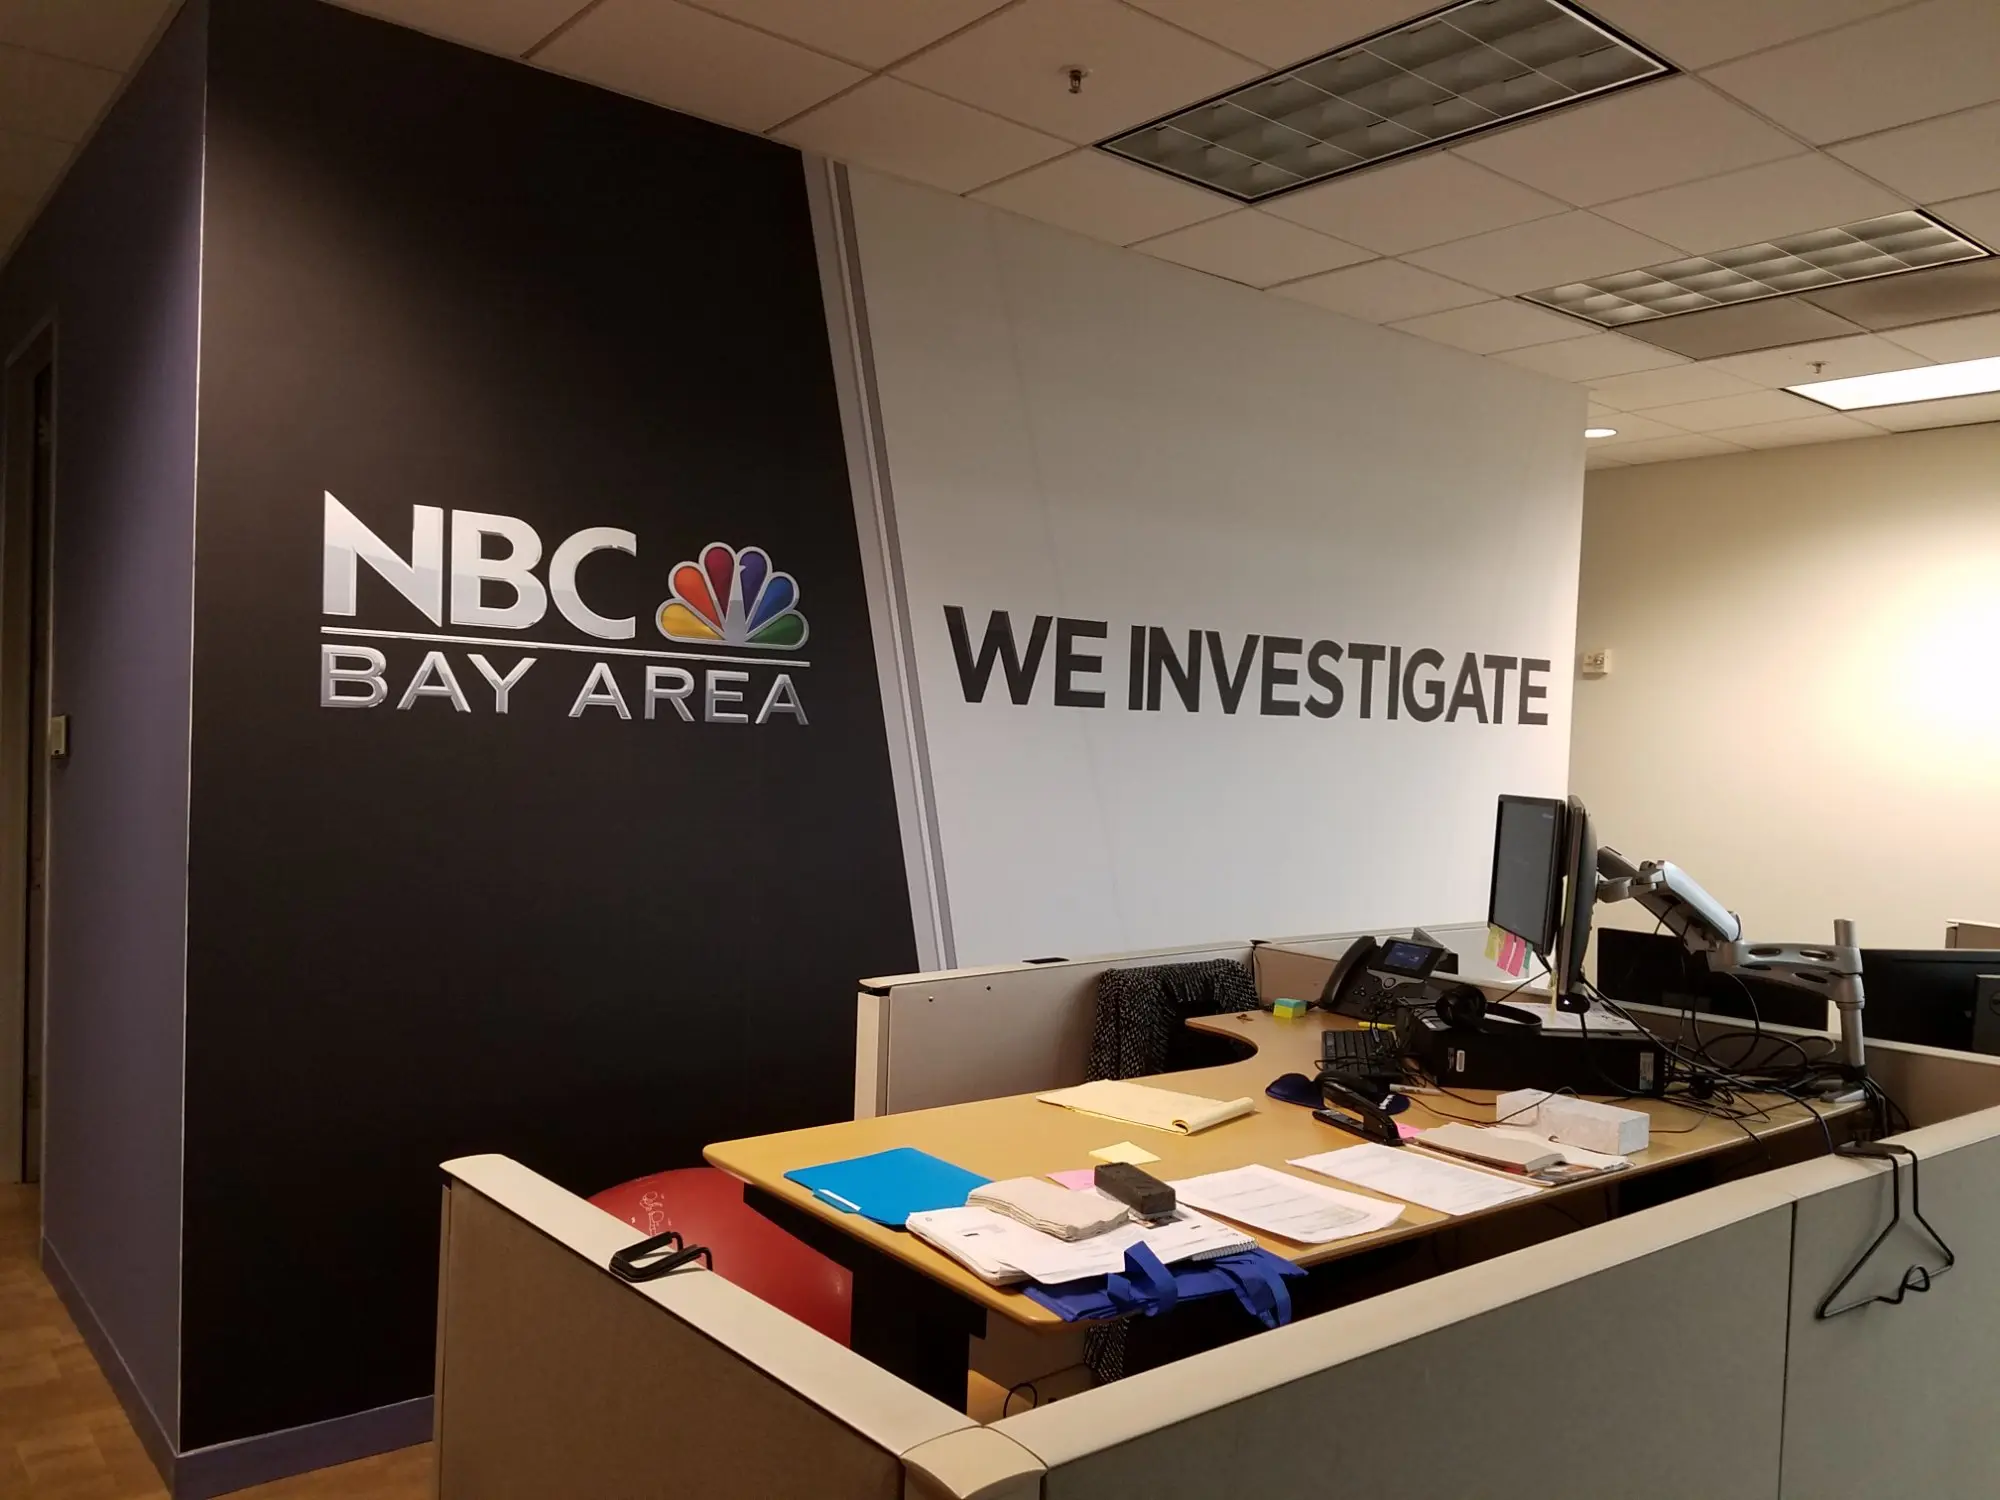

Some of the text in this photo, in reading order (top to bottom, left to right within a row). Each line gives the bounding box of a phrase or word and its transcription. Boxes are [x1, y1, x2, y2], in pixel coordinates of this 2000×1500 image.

[322, 490, 637, 640] NBC
[320, 644, 810, 726] BAY AREA
[943, 605, 1551, 726] WE INVESTIGATE
